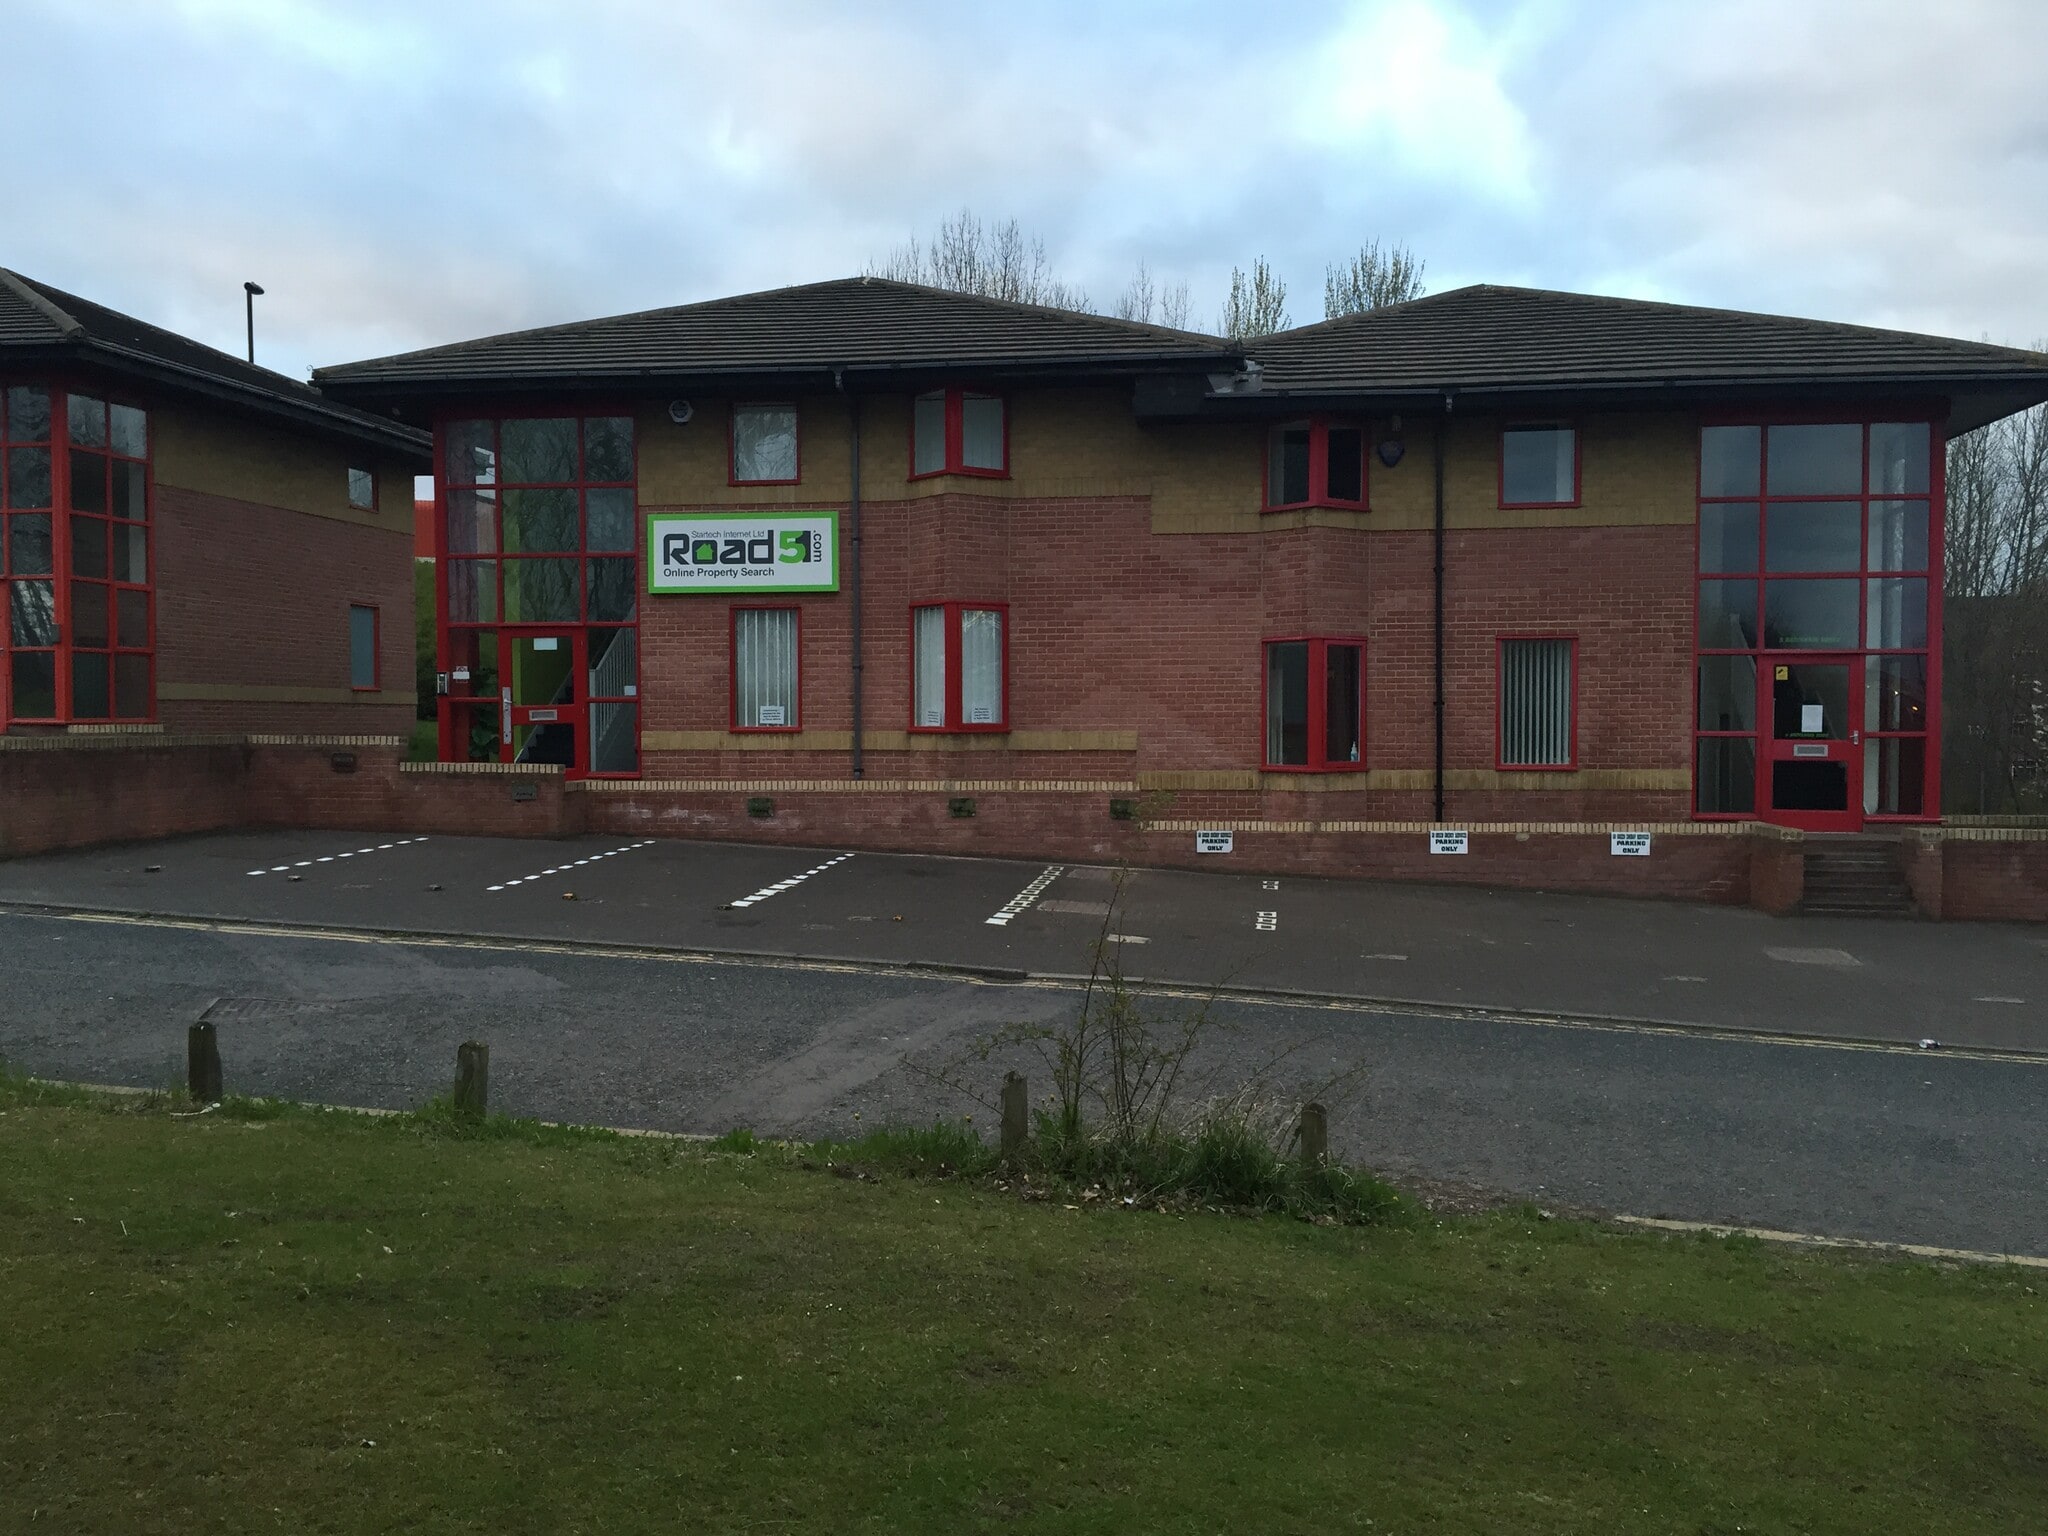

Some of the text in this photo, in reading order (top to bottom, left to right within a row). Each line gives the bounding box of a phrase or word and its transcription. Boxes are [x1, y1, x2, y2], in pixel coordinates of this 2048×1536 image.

[691, 530, 765, 539] Startech Internet Ltd
[813, 530, 822, 563] .com
[663, 567, 775, 579] Online Property Search
